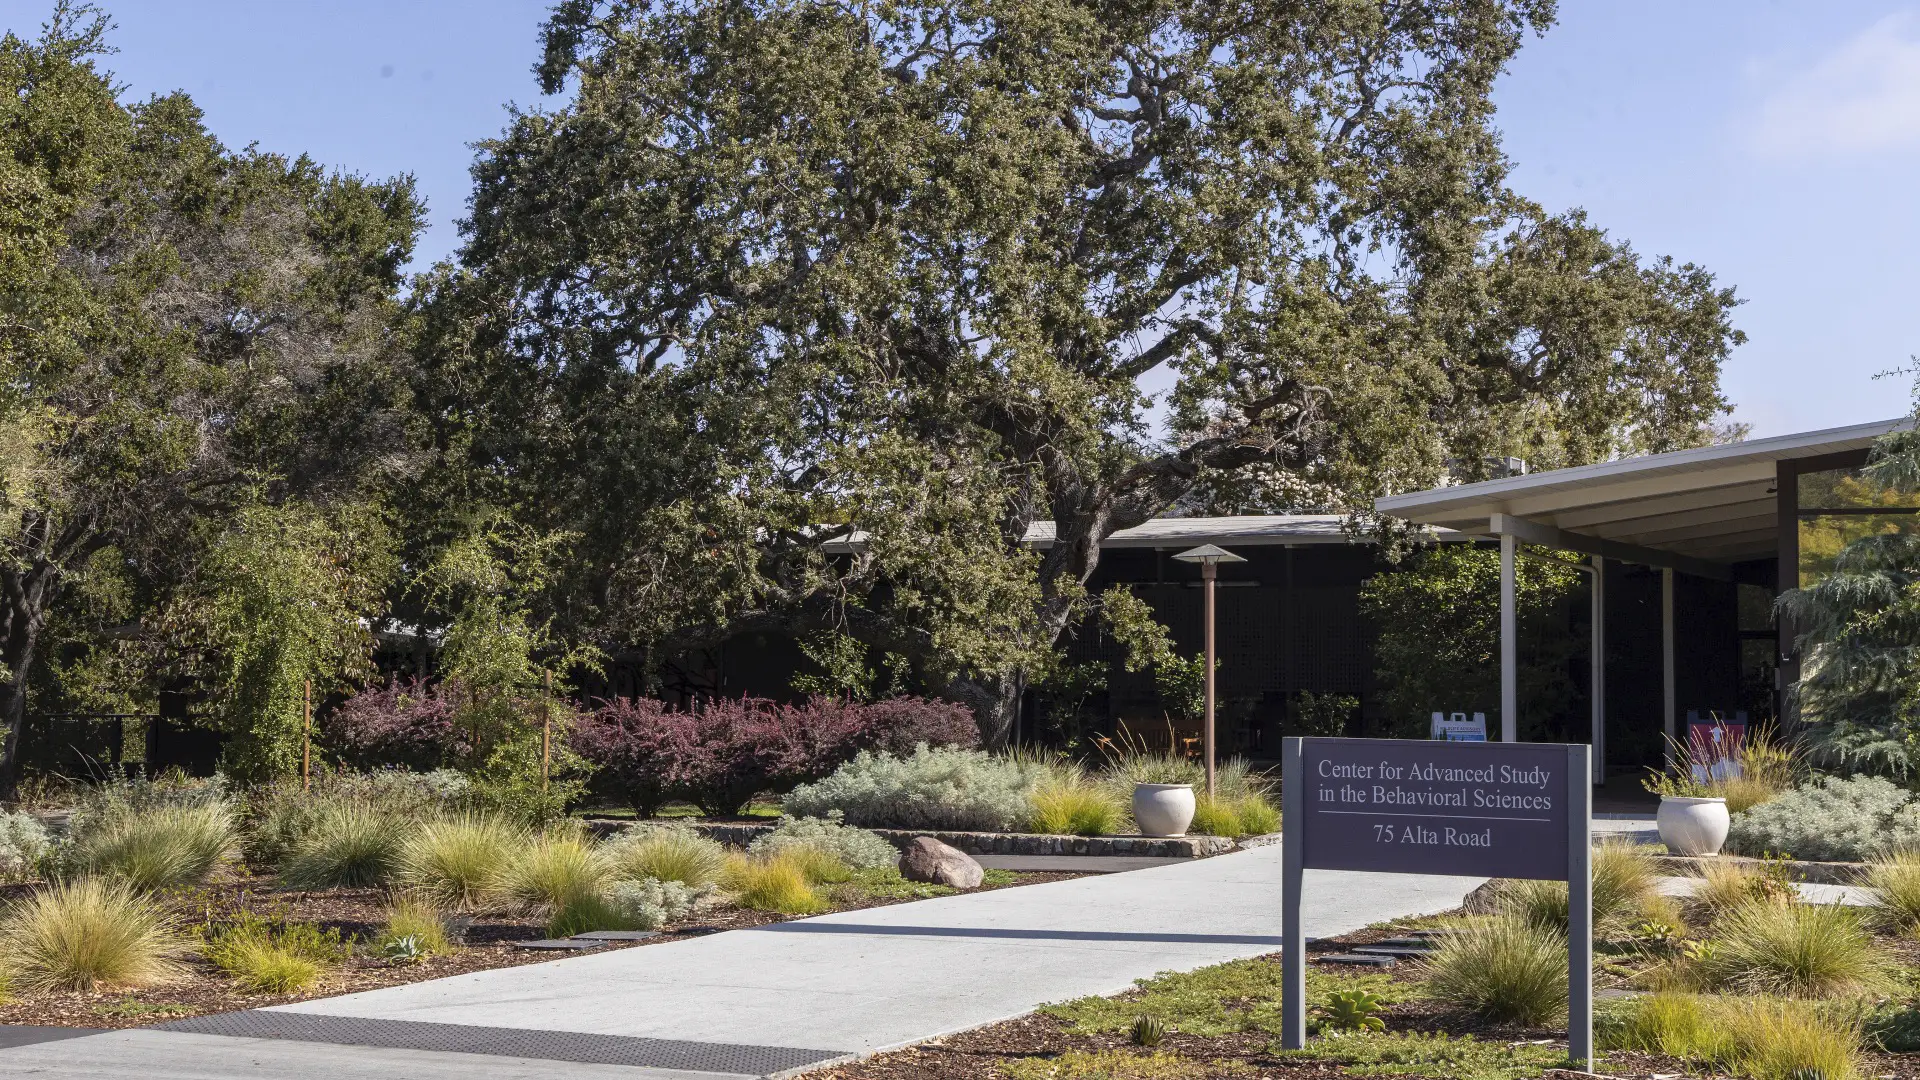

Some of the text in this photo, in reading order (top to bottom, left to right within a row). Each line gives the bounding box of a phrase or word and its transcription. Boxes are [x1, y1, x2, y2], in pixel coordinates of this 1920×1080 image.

[1318, 760, 1551, 789] Center for Advanced Study
[1318, 784, 1552, 809] in the Behavioral Sciences
[1373, 825, 1491, 847] 75 Alta Road
